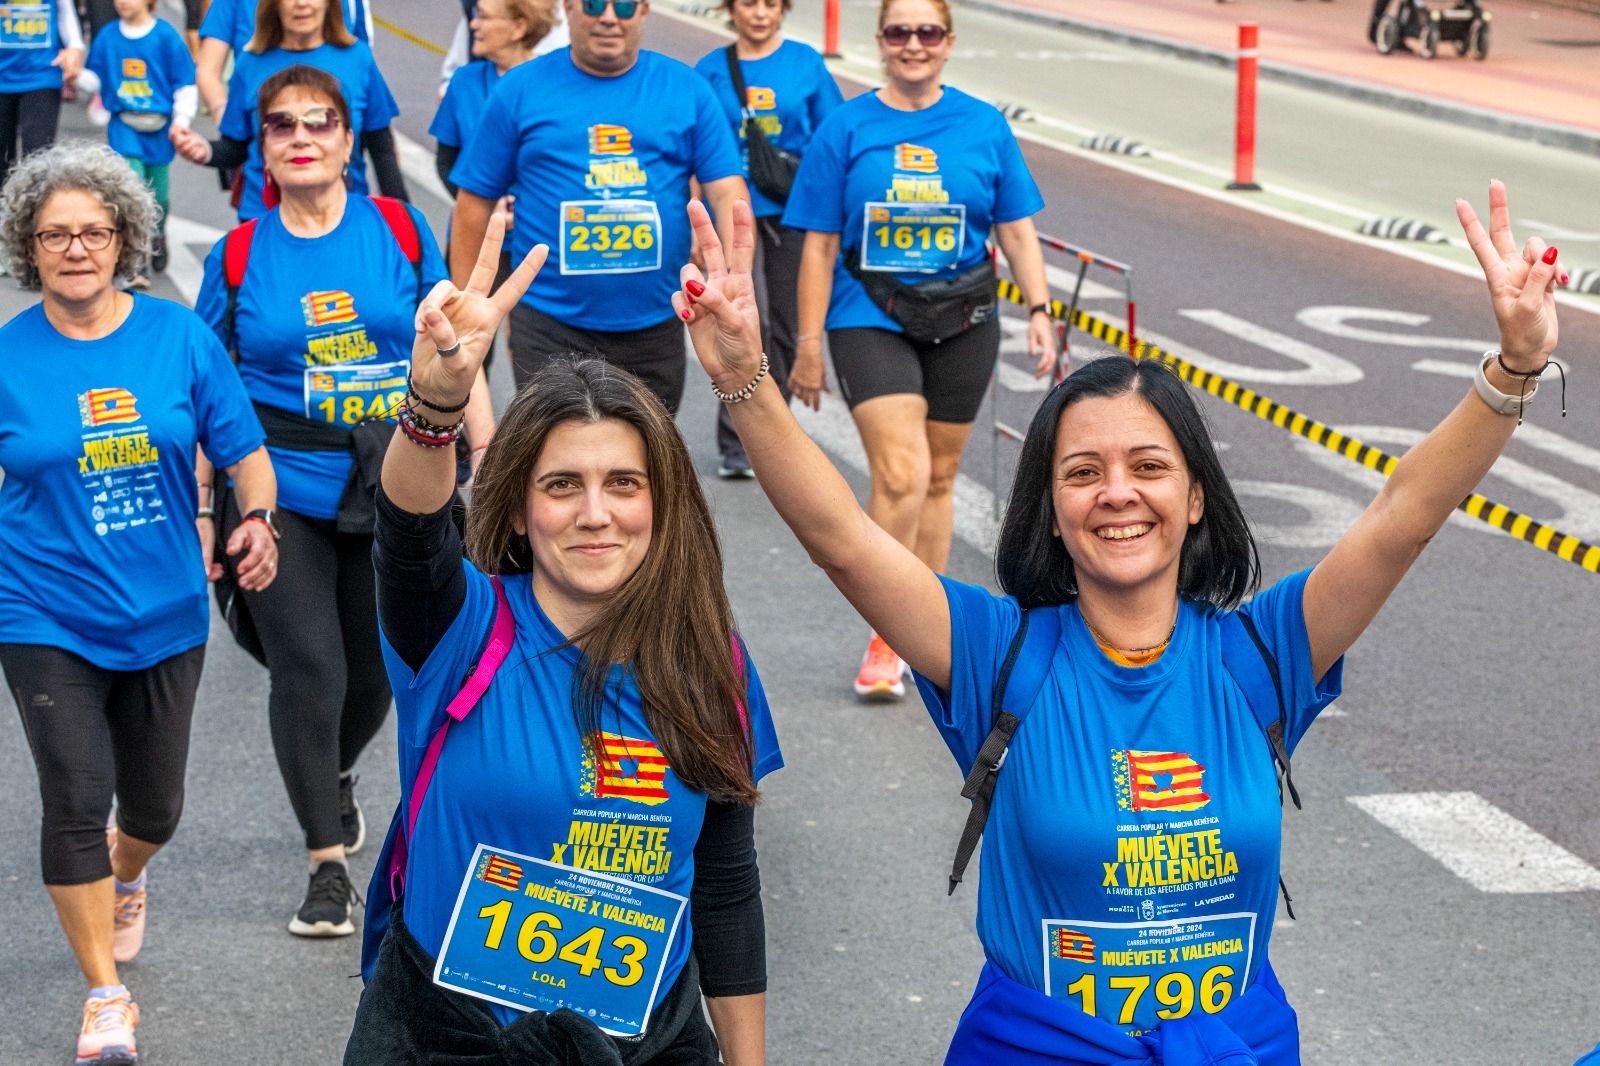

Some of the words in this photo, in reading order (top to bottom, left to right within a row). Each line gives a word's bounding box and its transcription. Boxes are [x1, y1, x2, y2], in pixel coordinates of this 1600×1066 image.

[569, 224, 654, 252] 2326
[875, 225, 955, 251] 1616
[83, 432, 150, 457] MUÉVETE
[91, 446, 159, 471] VALENCIA
[573, 808, 597, 818] CARRERA
[597, 810, 622, 819] POPULAR
[627, 813, 650, 822] MARCHA
[650, 813, 672, 823] BENÉFICA
[1116, 824, 1140, 832] CARRERA
[1140, 822, 1164, 832] POPULAR
[1165, 822, 1168, 830] Y
[1169, 820, 1193, 829] MARCHA
[1193, 816, 1219, 827] BENÉFICA
[567, 818, 670, 851] MUÉVETE
[1116, 828, 1223, 863] MUÉVETE
[550, 842, 569, 865] X
[572, 844, 672, 875] VALENCIA
[1102, 862, 1119, 887] X
[1125, 851, 1239, 888] VALENCIA
[568, 873, 577, 882] 24
[578, 875, 615, 892] NOVIEMBRE
[615, 885, 633, 896] 2024
[634, 874, 647, 883] POR
[1112, 888, 1133, 896] FAVOR
[1134, 888, 1143, 896] DE
[1144, 887, 1156, 895] LOS
[1157, 883, 1194, 894] AFECTADOS
[1195, 881, 1209, 889] POR
[1210, 879, 1218, 887] LA
[1219, 875, 1236, 885] DANA
[524, 882, 587, 913] MUÉVETE
[590, 900, 600, 917] X
[603, 904, 666, 933] VALENCIA
[478, 899, 648, 987] 1643
[1126, 938, 1149, 947] CARRERA
[1149, 936, 1171, 945] POPULAR
[1175, 934, 1193, 943] MARCHA
[1138, 929, 1147, 938] 24
[1148, 926, 1184, 937] NOVIEMBRE
[1186, 923, 1203, 933] 2024
[1102, 948, 1166, 967] MUÉVETE
[1169, 949, 1179, 963] X
[1182, 938, 1243, 960] VALENCIA
[532, 970, 567, 989] LOLA
[1067, 964, 1236, 1026] 1796
